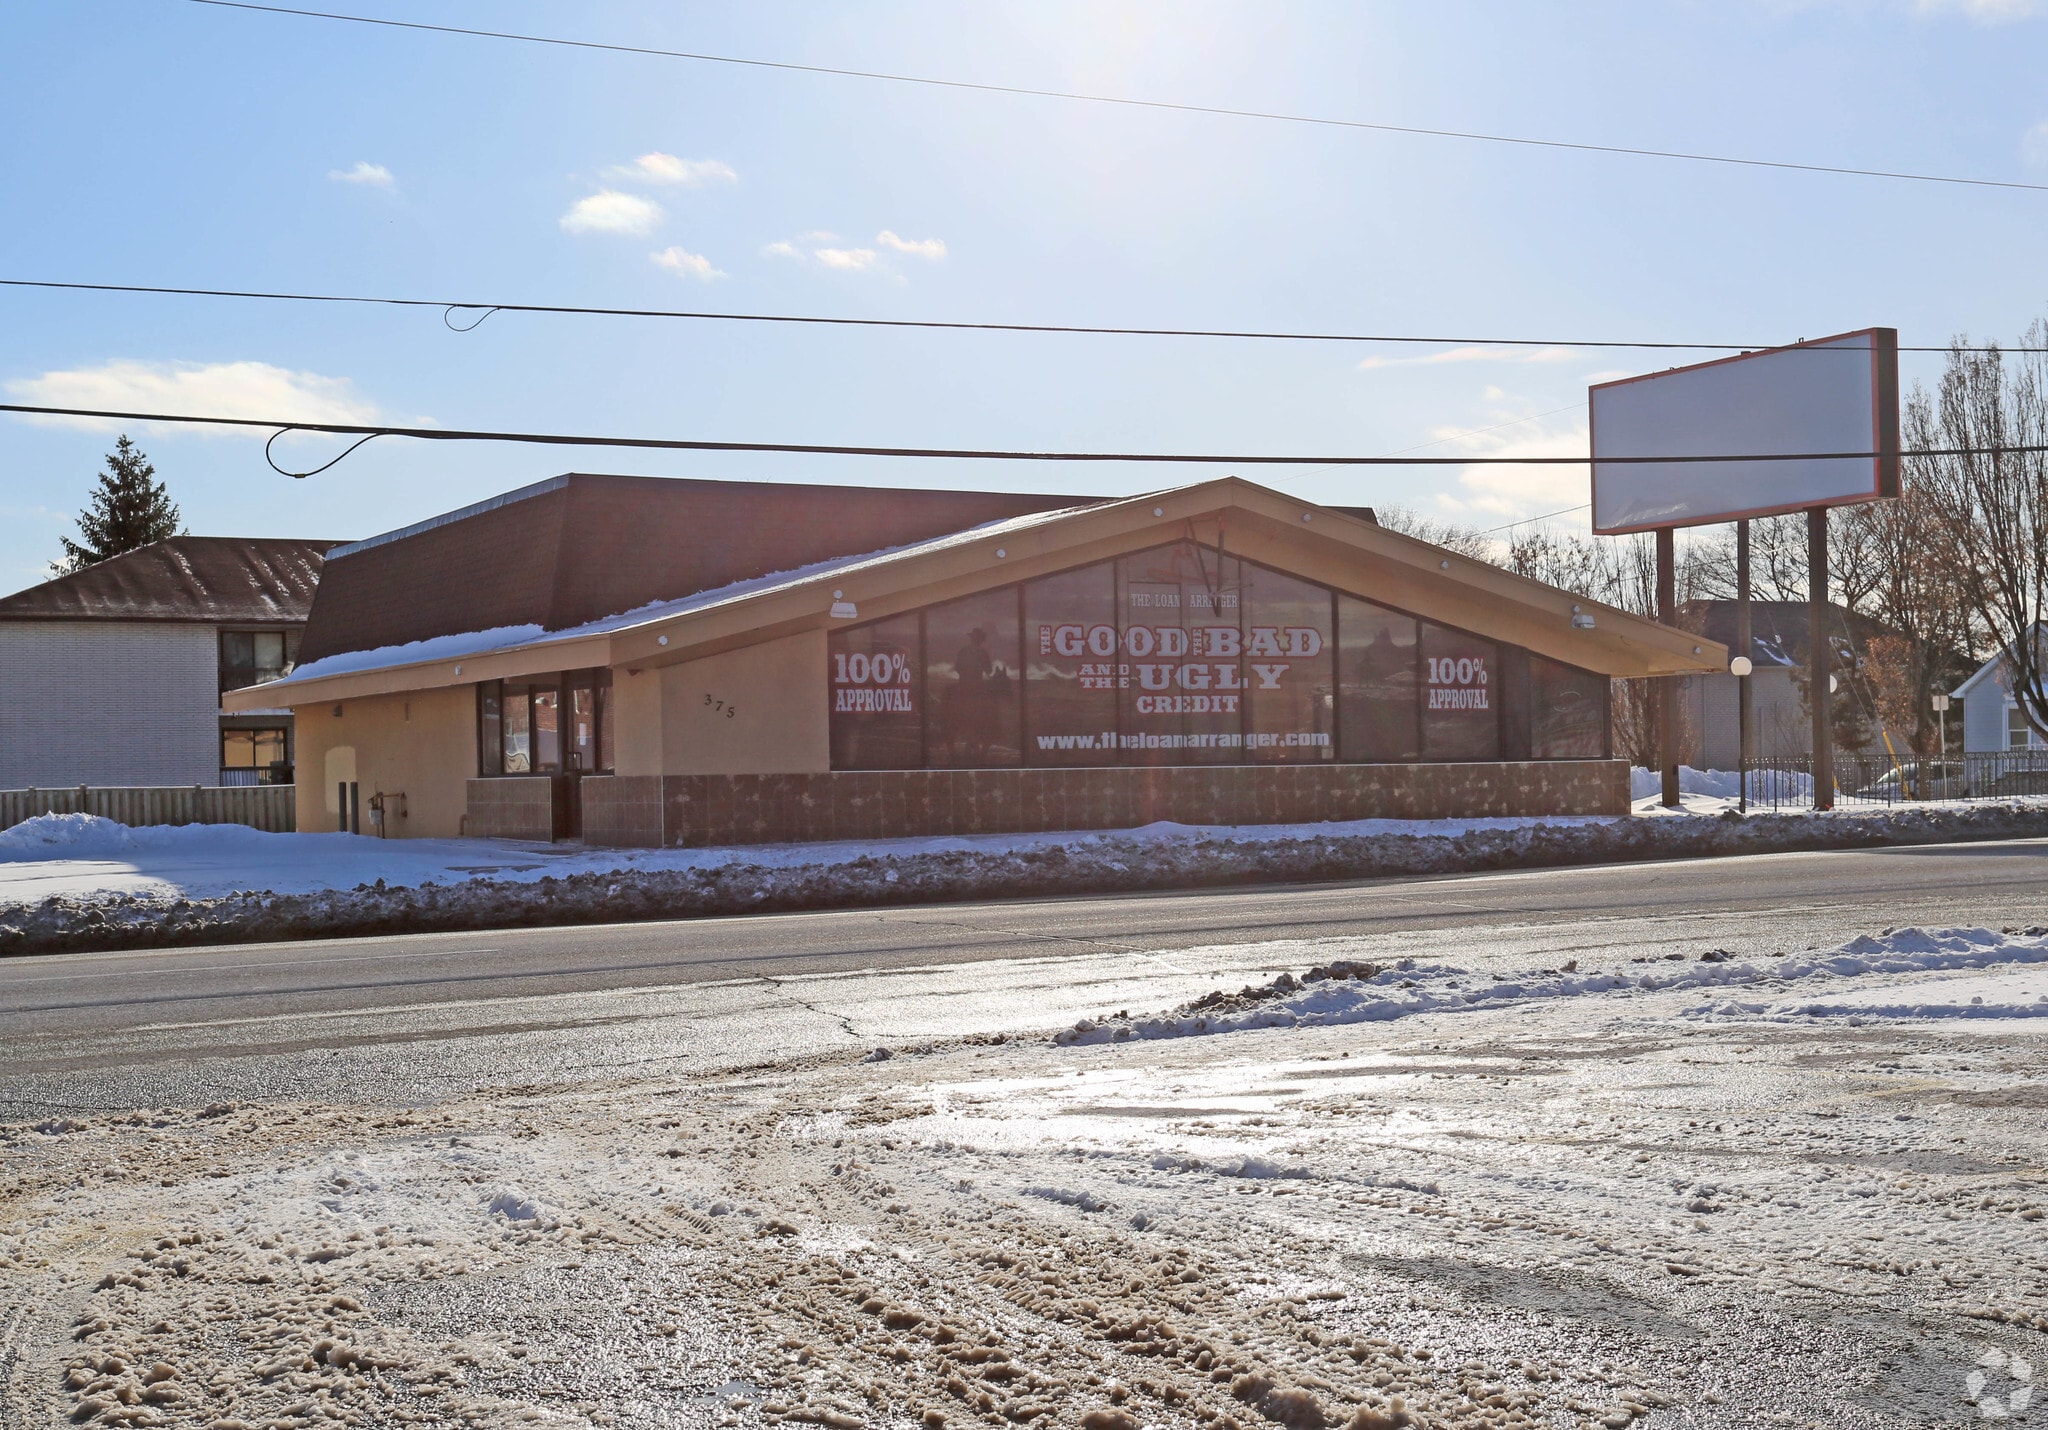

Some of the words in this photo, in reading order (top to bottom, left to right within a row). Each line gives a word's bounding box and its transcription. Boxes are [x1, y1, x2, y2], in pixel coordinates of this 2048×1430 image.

[1131, 593, 1151, 607] THE
[1155, 594, 1180, 607] LOAN
[1190, 594, 1238, 608] ARRGER
[1040, 626, 1050, 655] THE
[1053, 626, 1190, 657] GOOD
[1193, 629, 1202, 656] THE
[1204, 628, 1323, 657] BAD
[835, 653, 911, 684] 100%
[1079, 664, 1130, 675] AND
[1080, 677, 1130, 689] THE
[1136, 663, 1290, 690] UGLY
[1428, 657, 1488, 685] 100%
[704, 694, 735, 719] 375
[835, 688, 912, 712] APPROVAL
[1136, 695, 1239, 713] CREDIT
[1428, 688, 1489, 709] APPROVAL
